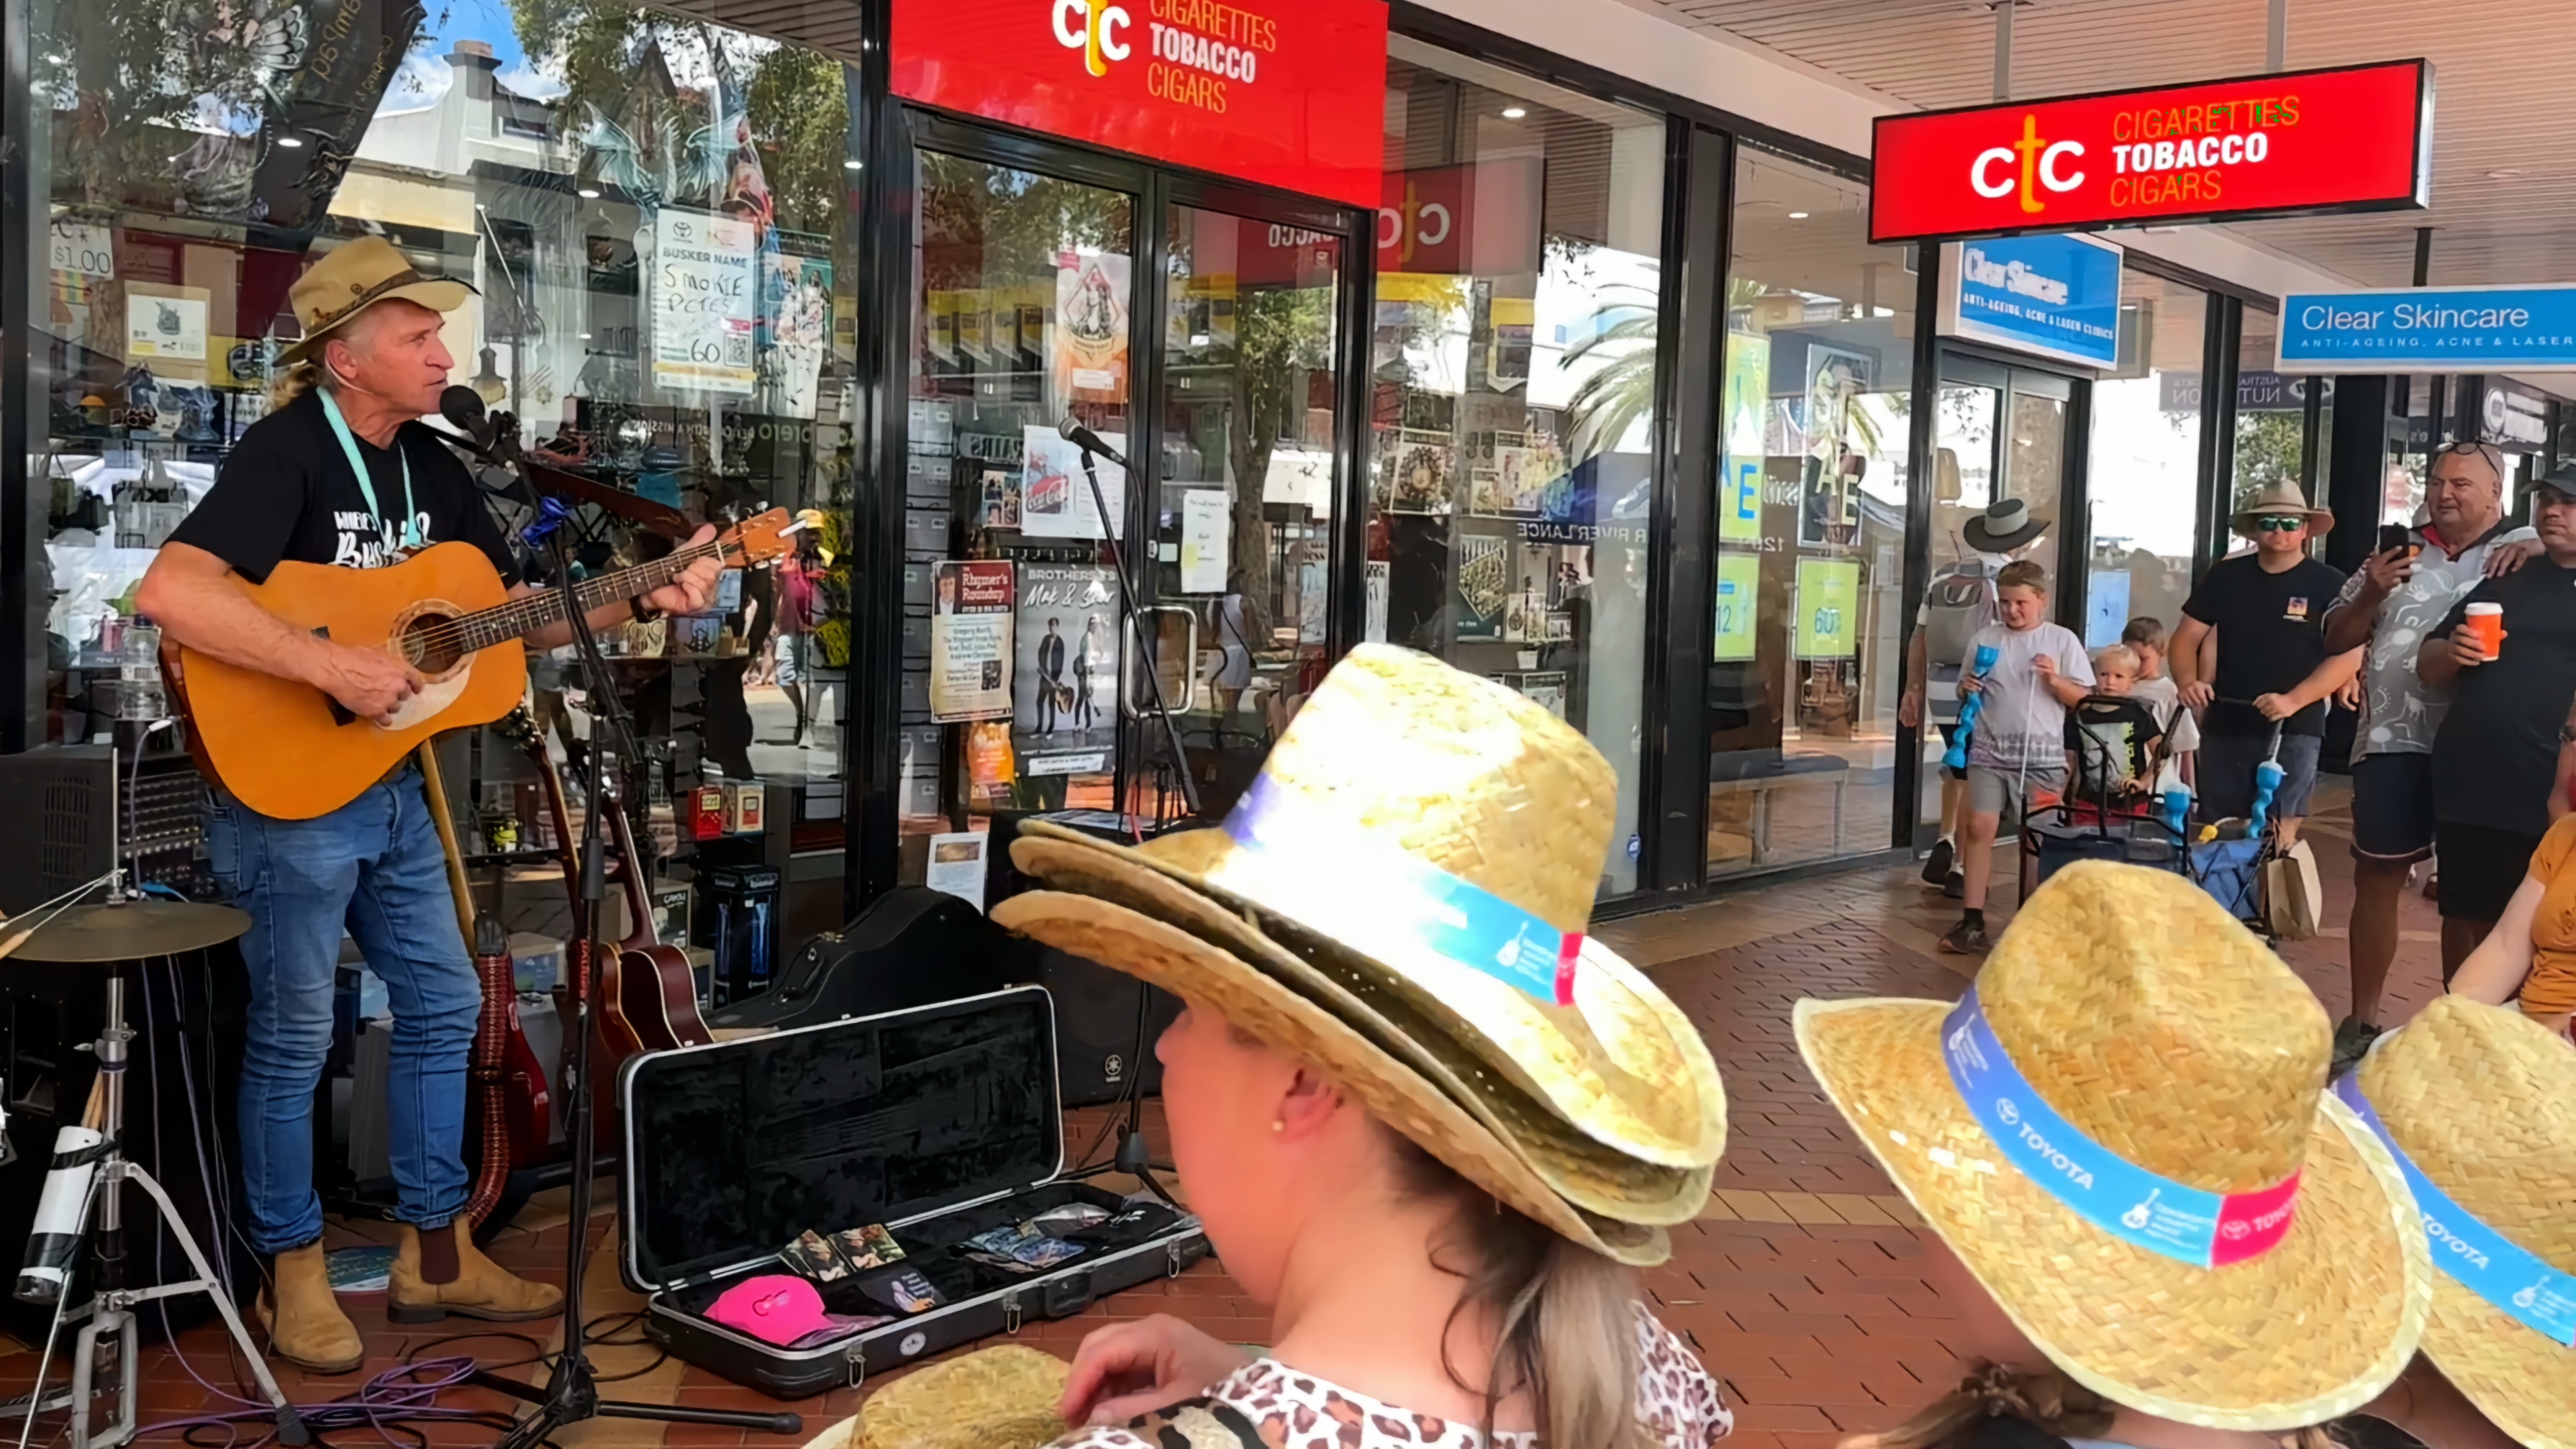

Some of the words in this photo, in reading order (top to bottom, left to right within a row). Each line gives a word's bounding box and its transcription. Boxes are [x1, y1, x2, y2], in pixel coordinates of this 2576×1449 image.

[1150, 0, 1276, 52] CIGARETTES
[1149, 22, 1256, 83] TOBACCO
[1148, 62, 1226, 114] CIGARS
[2113, 95, 2300, 142] CIGARETTES
[1970, 114, 2085, 213] ctc
[2112, 132, 2269, 174] TOBACCO
[2110, 169, 2222, 207] CIGARS
[54, 246, 111, 274] $1.00
[663, 247, 712, 263] BUSKER
[714, 254, 748, 268] NAME
[2303, 305, 2385, 330] Clear
[2393, 302, 2529, 330] Skincare
[691, 338, 720, 363] 60
[2436, 337, 2484, 347] ACNE
[2513, 335, 2573, 346] LASER
[962, 573, 1009, 589] Rhymer's
[962, 587, 1005, 603] Roundup
[1061, 582, 1076, 607] &
[2018, 1122, 2095, 1190] TOYOTA
[2422, 1211, 2490, 1270] TOYOTA
